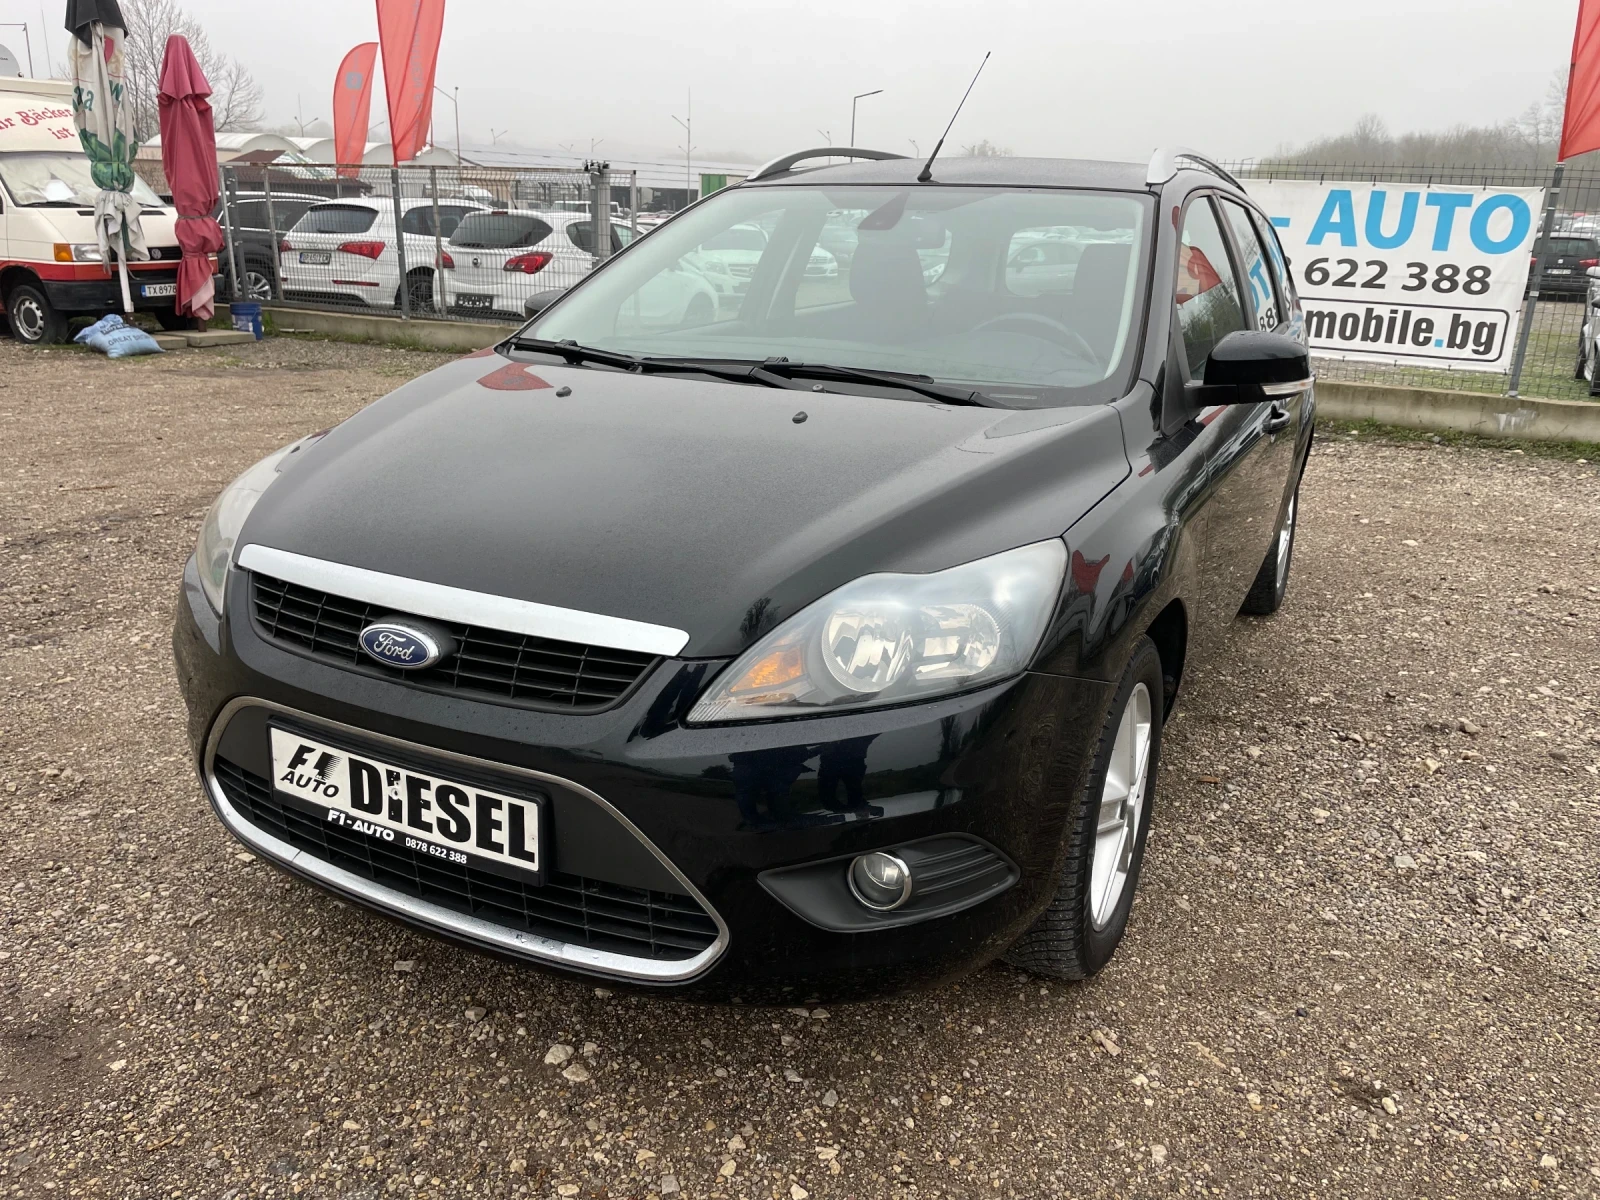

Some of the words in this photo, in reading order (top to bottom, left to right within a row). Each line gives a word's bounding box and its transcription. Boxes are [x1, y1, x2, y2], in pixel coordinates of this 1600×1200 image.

[15, 107, 74, 126] Bäcker
[47, 127, 75, 139] ist
[1306, 189, 1531, 255] AUTO
[1304, 257, 1389, 289] 622
[1401, 261, 1491, 295] 388
[147, 286, 158, 295] TX
[1305, 307, 1498, 356] mobile.bg
[373, 632, 416, 661] Ford
[280, 770, 339, 798] AUTO
[405, 837, 428, 854] 0878
[429, 844, 447, 859] 622
[449, 849, 467, 865] 388
